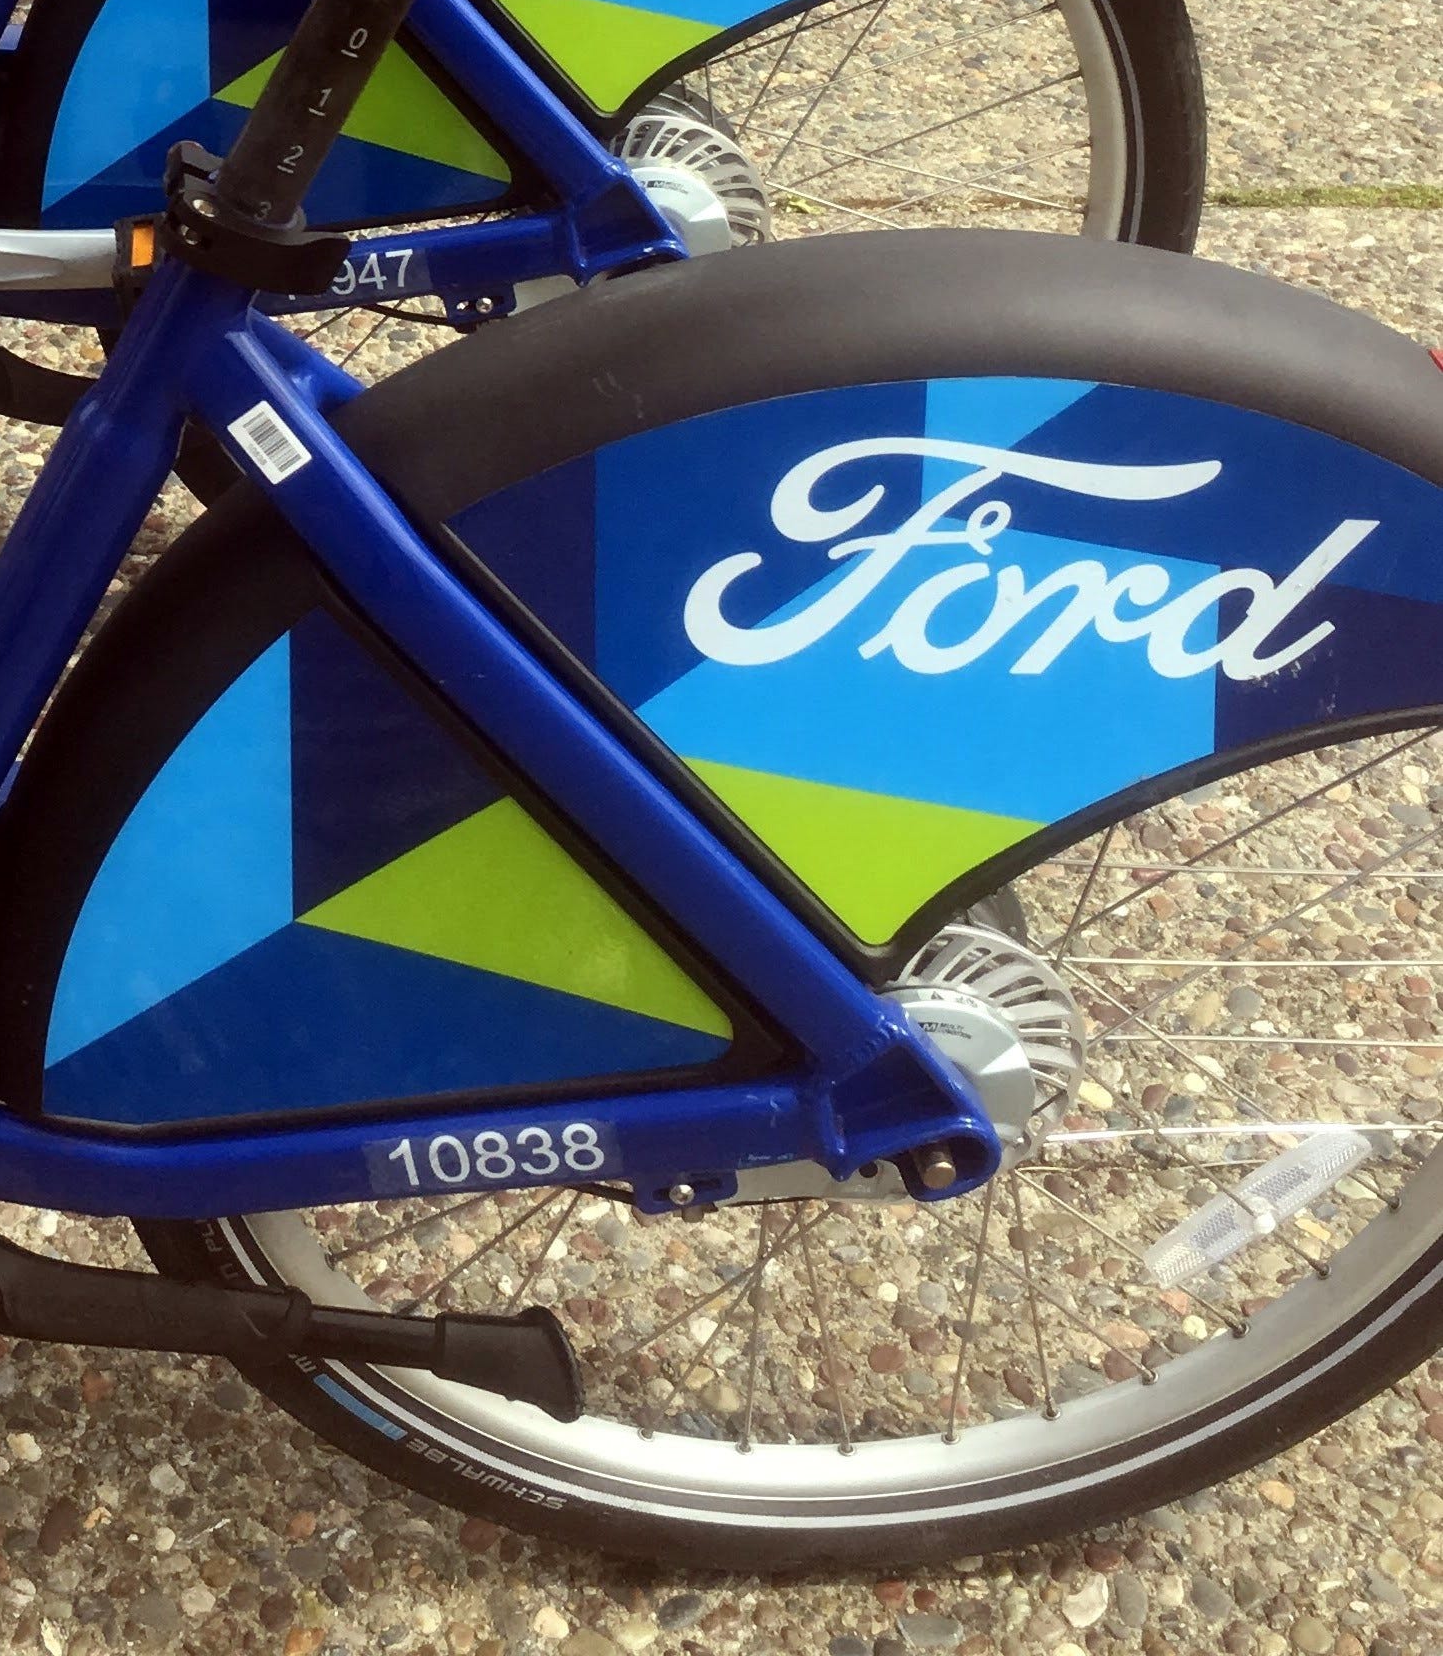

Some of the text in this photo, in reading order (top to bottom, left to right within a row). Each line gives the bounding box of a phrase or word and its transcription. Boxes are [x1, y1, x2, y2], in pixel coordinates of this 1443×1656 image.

[683, 436, 1381, 682] Ford
[387, 1122, 606, 1188] 10838
[407, 1438, 568, 1511] SCHWALBE
